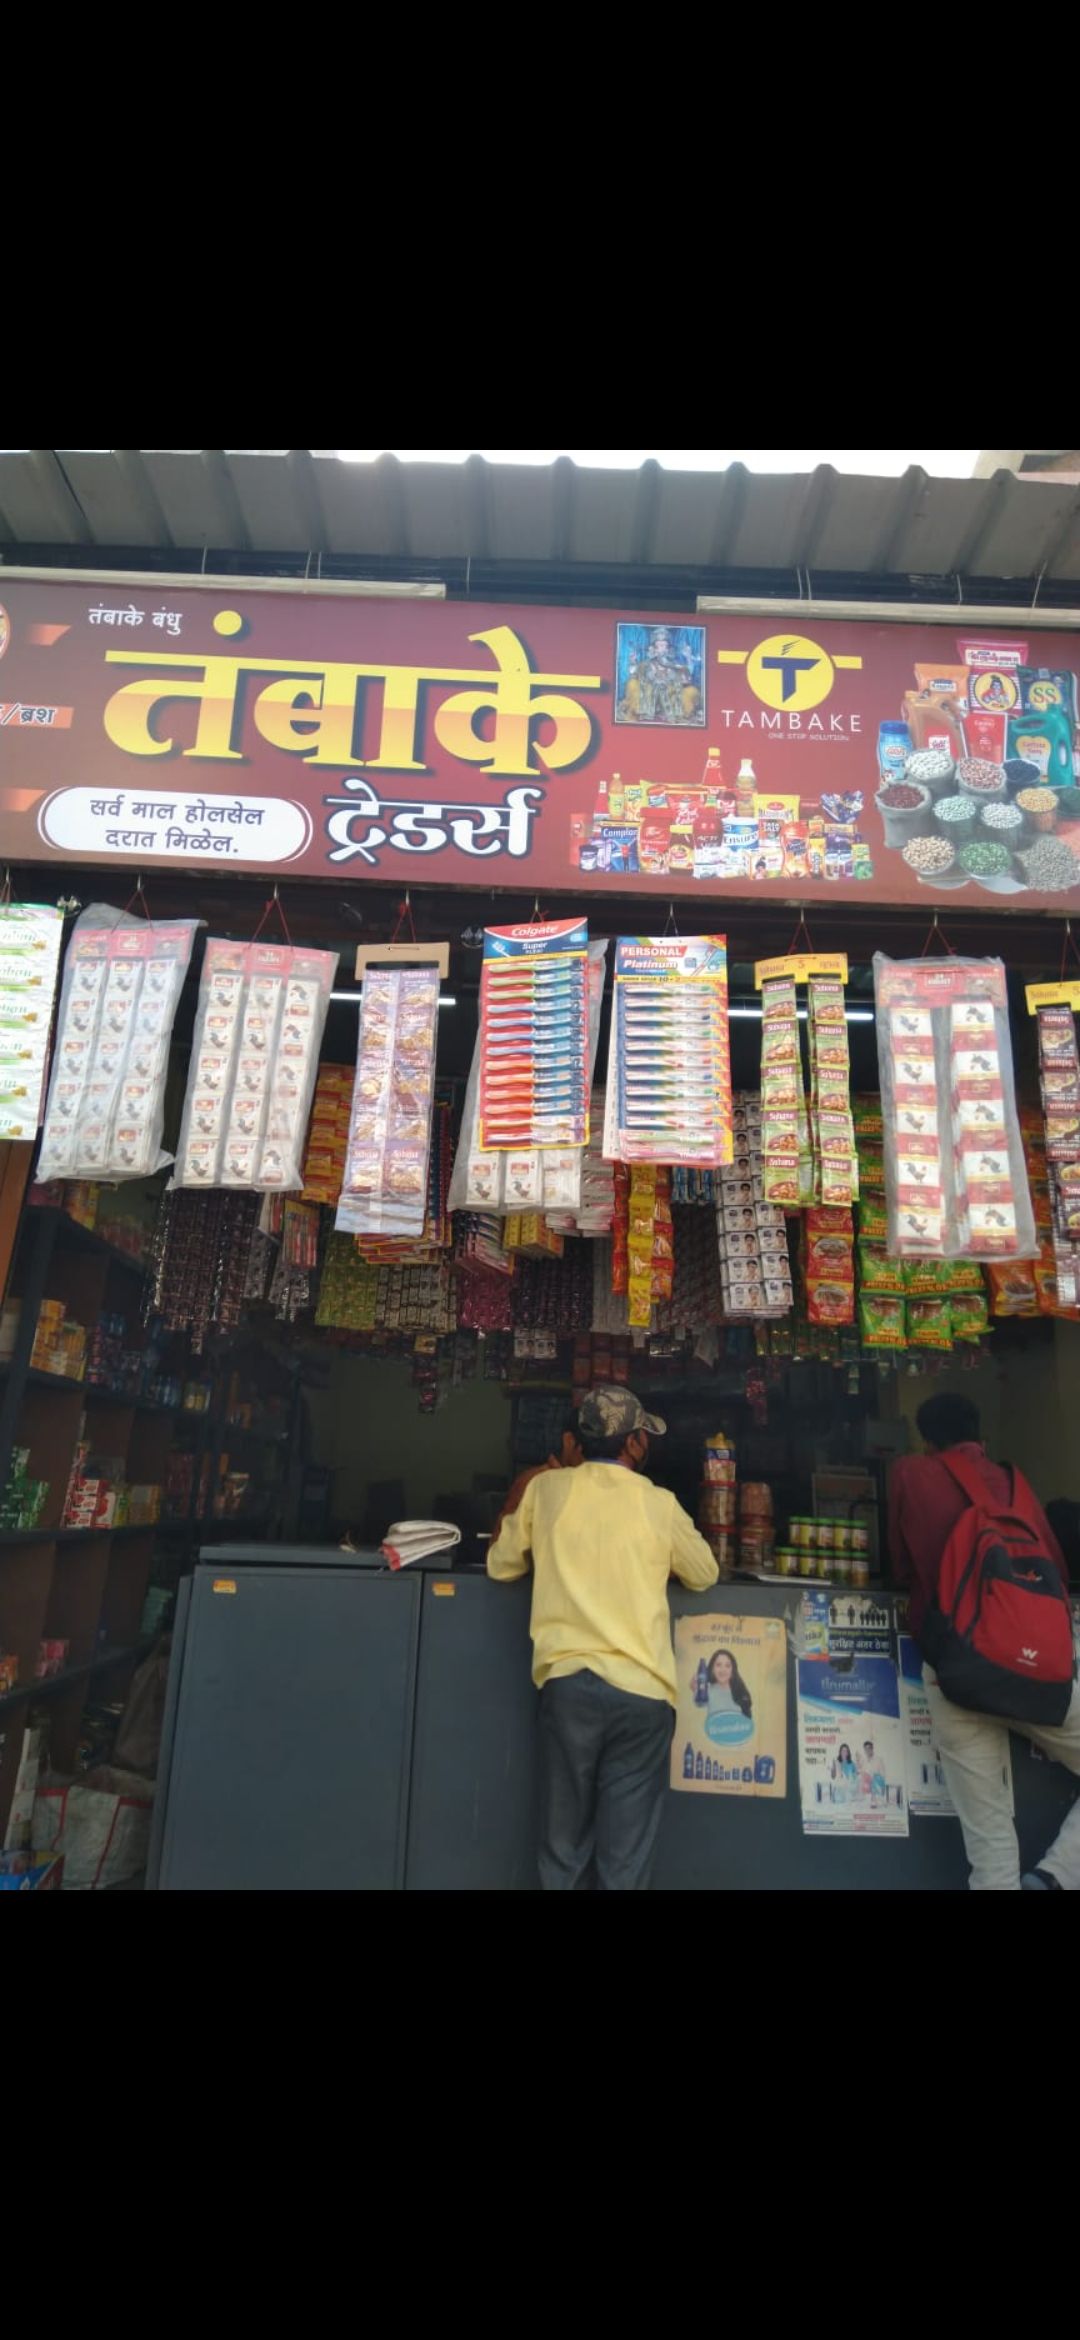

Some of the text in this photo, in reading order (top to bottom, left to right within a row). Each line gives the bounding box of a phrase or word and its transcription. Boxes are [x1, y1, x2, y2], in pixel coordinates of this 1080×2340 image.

[88, 603, 183, 636] तंबाके बंधु
[103, 609, 602, 775] तंबाके
[720, 708, 862, 733] TAMBAKE
[90, 795, 266, 826] सर्व माल होलसेल
[325, 778, 542, 864] ट्रेडर्स
[105, 826, 240, 854] दरात मिळेल.
[511, 925, 559, 937] Colgate
[621, 946, 683, 957] PERSONAL
[623, 959, 678, 969] Platinum
